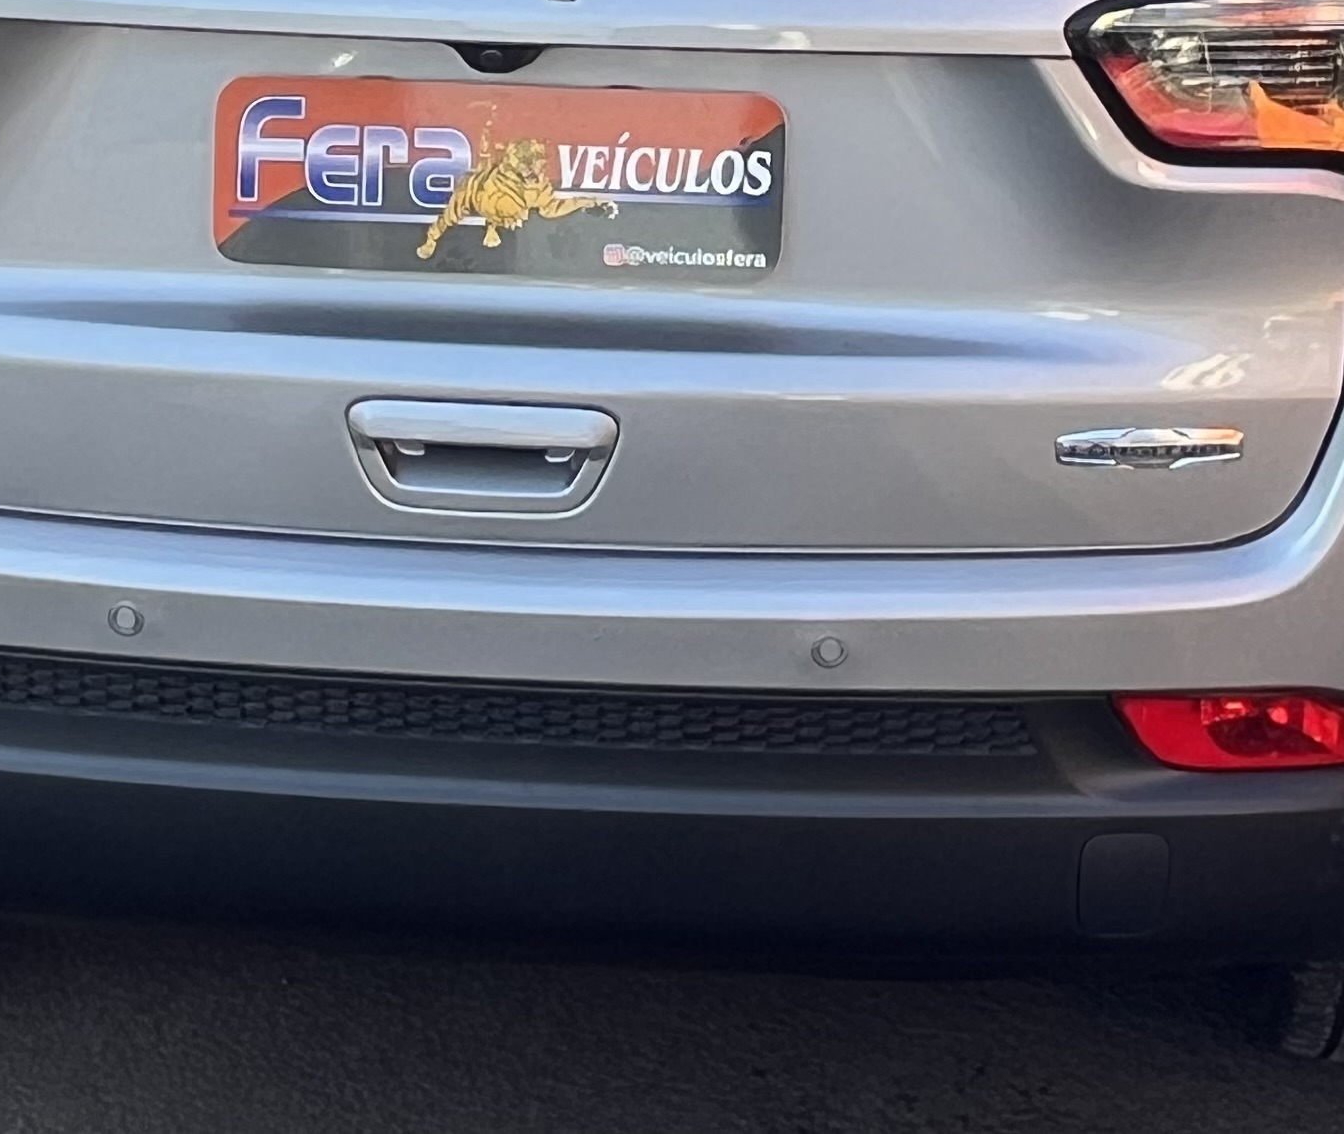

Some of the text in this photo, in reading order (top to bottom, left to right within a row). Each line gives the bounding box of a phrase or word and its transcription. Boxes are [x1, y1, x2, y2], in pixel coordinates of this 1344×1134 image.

[237, 96, 772, 209] Fera VEÍCULOS
[626, 245, 767, 268] @veiculosfera
